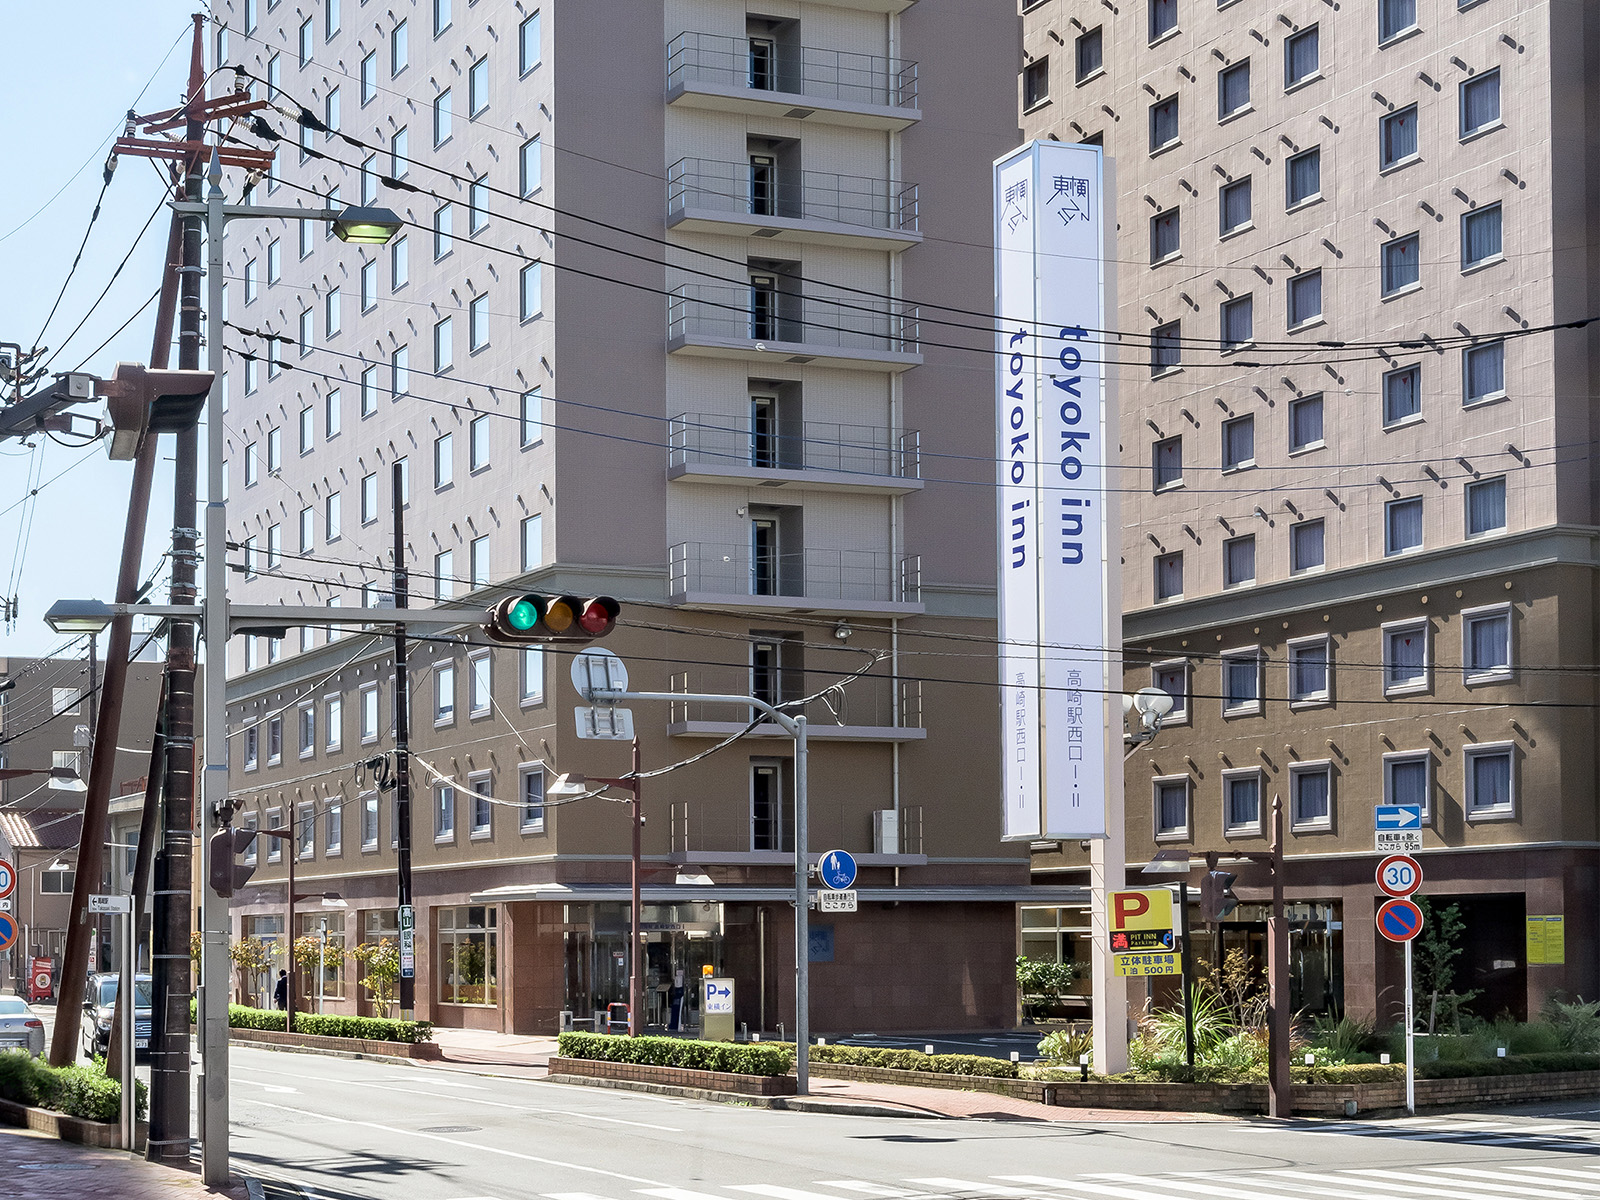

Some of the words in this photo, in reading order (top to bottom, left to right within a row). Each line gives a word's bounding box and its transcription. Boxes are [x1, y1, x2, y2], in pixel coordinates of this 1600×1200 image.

[1006, 328, 1030, 484] toyoko
[1053, 325, 1091, 480] toyoko
[1012, 499, 1030, 569] inn
[1061, 498, 1091, 565] inn
[1377, 843, 1401, 851] ここから
[1404, 842, 1420, 851] 95m
[1387, 867, 1412, 885] 30
[824, 901, 854, 909] ここから
[1114, 892, 1150, 929] P
[1112, 932, 1128, 949] 満
[1130, 933, 1141, 941] PIT
[1120, 954, 1174, 966] 立体駐車場
[707, 983, 717, 1000] P
